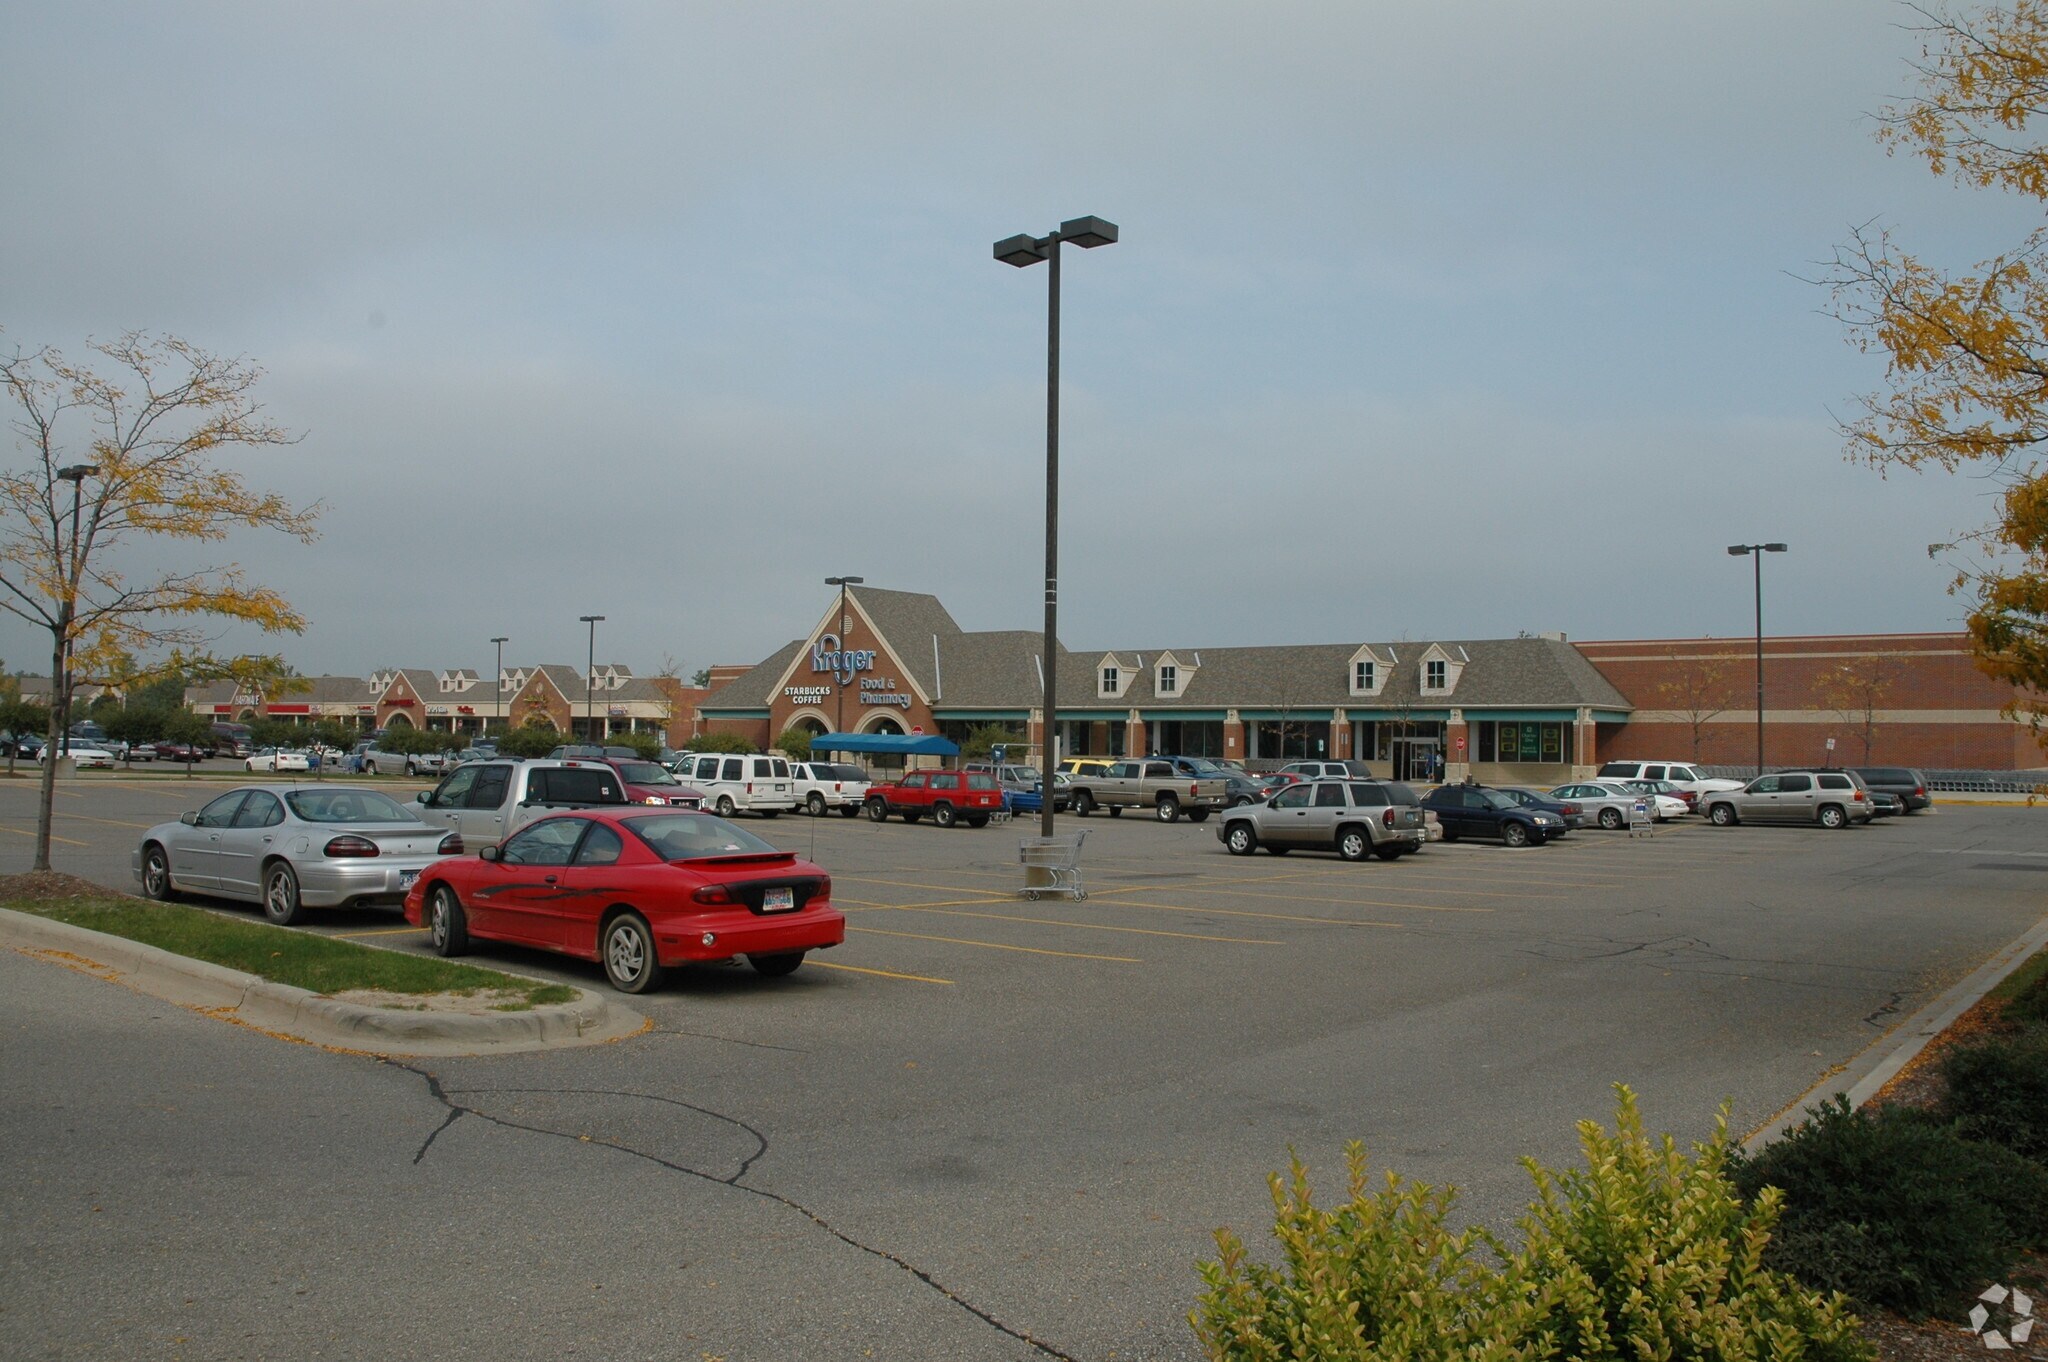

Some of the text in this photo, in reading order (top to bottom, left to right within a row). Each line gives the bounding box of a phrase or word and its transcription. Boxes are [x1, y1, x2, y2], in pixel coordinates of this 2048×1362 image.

[811, 633, 876, 685] Kroger
[860, 677, 895, 689] Food &
[784, 686, 831, 696] STARBUCKS
[792, 695, 822, 704] COFFEE
[860, 691, 912, 709] Pharmacy
